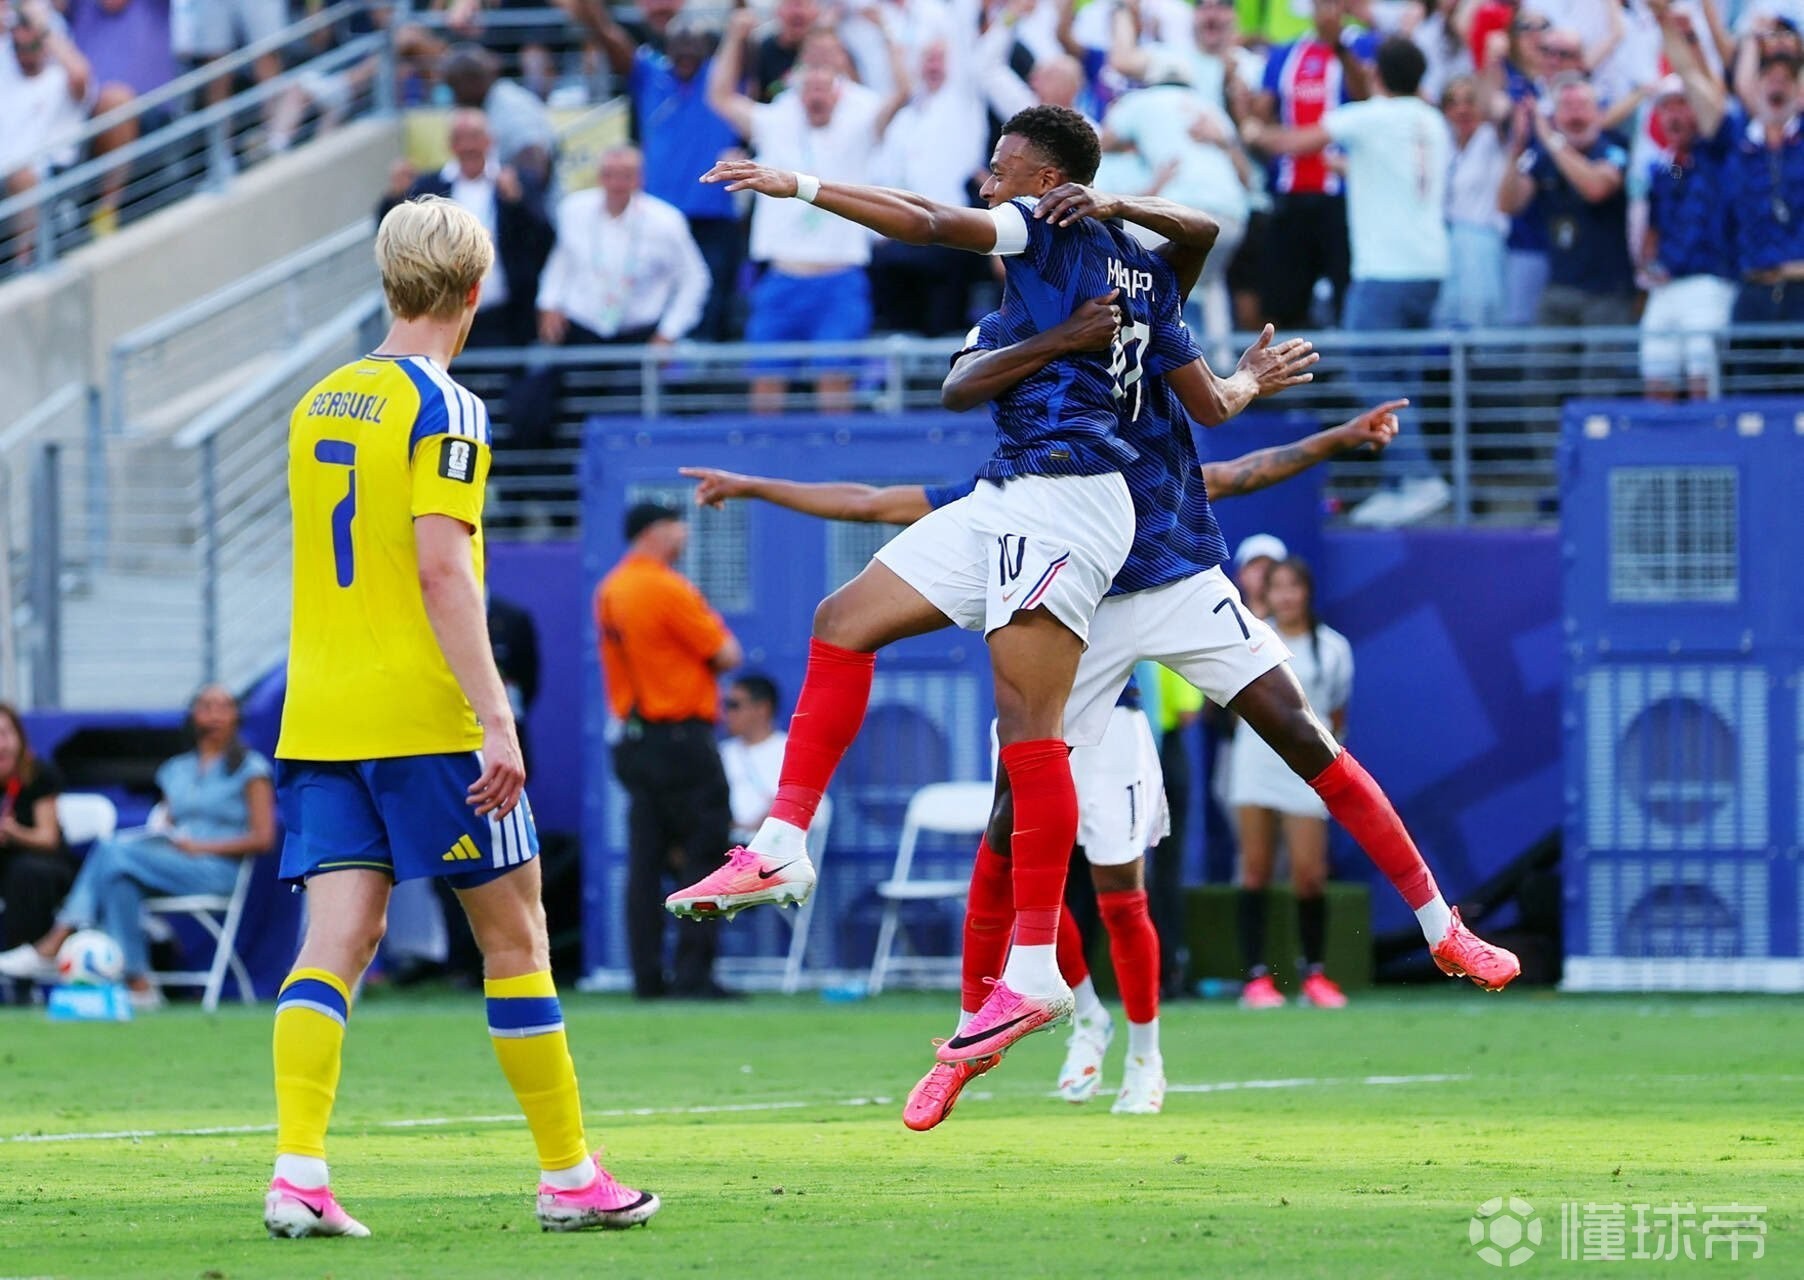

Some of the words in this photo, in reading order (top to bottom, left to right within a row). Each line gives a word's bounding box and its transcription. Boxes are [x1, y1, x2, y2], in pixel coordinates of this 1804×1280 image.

[314, 439, 356, 588] 7
[998, 533, 1027, 586] 10
[1212, 597, 1250, 640] 7
